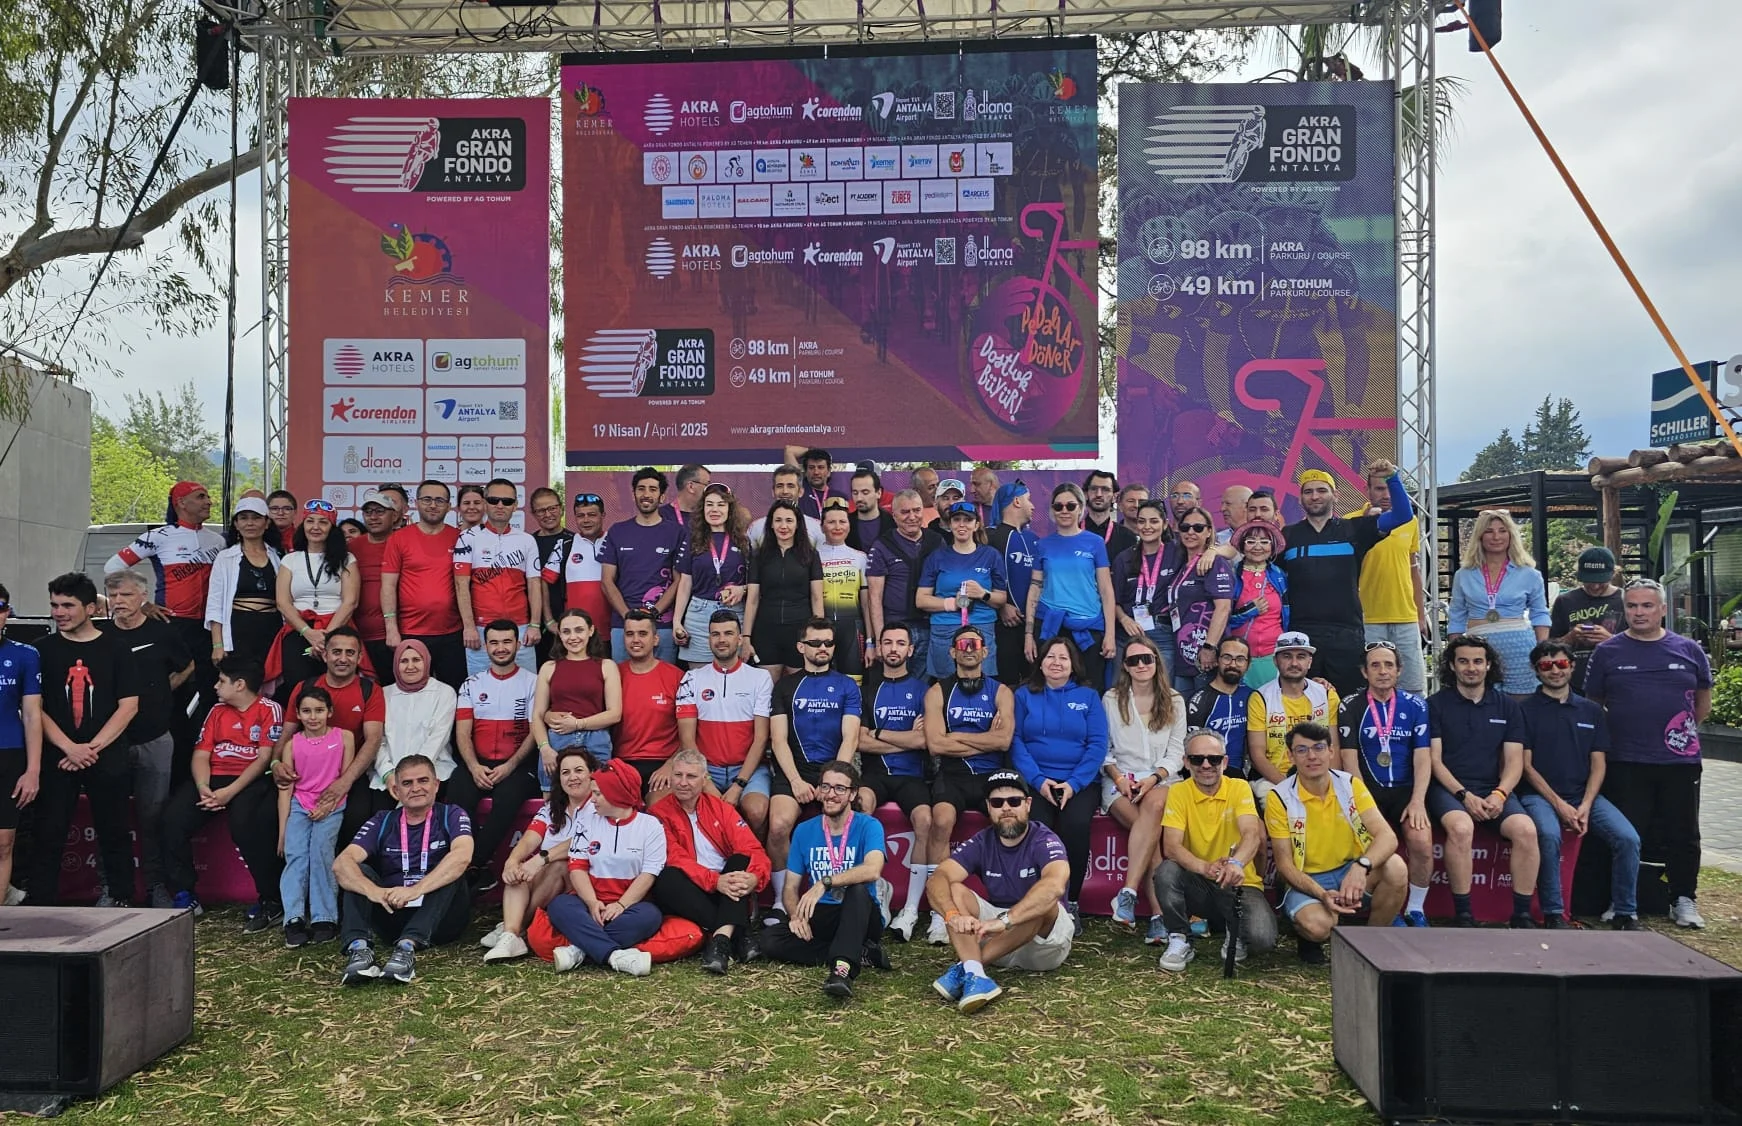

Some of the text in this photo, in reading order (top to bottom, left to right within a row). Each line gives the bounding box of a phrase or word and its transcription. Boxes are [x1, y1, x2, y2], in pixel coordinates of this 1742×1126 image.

[680, 100, 719, 113] AKRA
[896, 104, 933, 112] ANTALYA
[978, 90, 1012, 114] diana
[747, 104, 792, 119] agtohum
[817, 104, 862, 117] corendon
[1049, 105, 1088, 114] KEMER
[576, 120, 613, 128] KEMER
[680, 117, 720, 127] HOTELS
[896, 114, 917, 122] Airport
[1298, 116, 1341, 126] AKRA
[471, 129, 512, 139] AKRA
[1282, 129, 1342, 145] GRAN
[456, 140, 512, 156] GRAN
[1269, 147, 1342, 163] FONDO
[444, 158, 512, 174] FONDO
[682, 245, 721, 258] AKRA
[897, 249, 934, 258] ANTALYA
[979, 236, 1013, 259] diana
[1180, 240, 1252, 259] 98 km
[1270, 242, 1304, 252] AKRA
[749, 249, 794, 263] agtohum
[818, 249, 863, 262] corendon
[1270, 252, 1311, 260] PARKURU
[1317, 252, 1351, 260] COURSE
[682, 261, 721, 270] HOTELS
[897, 259, 918, 267] Airport
[1180, 276, 1255, 295] 49 km
[1270, 279, 1332, 288] AG TOHUM
[385, 289, 469, 303] KEMER
[1270, 289, 1311, 297] PARKURU
[1317, 289, 1351, 297] COURSE
[677, 339, 705, 348] AKRA
[748, 340, 789, 355] 98 km
[798, 341, 818, 349] AKRA
[372, 352, 414, 362] AKRA
[455, 354, 519, 369] agtohum
[667, 350, 705, 364] GRAN
[372, 364, 415, 373] HOTELS
[660, 366, 705, 379] FONDO
[799, 370, 834, 378] AG TOHUM
[749, 368, 790, 383] 49 km
[352, 406, 417, 420] corendon
[458, 408, 496, 416] ANTALYA
[592, 424, 606, 437] 19
[609, 424, 641, 437] Nisan
[652, 423, 678, 439] April
[681, 423, 708, 436] 2025
[730, 425, 846, 435] www.akragranfondoantalya.org
[1651, 415, 1708, 438] SCHILLER
[360, 447, 402, 468] diana
[1569, 604, 1608, 622] ENJOY!
[962, 710, 993, 718] ANTALYA
[84, 827, 95, 841] 9
[1095, 836, 1128, 871] dia
[1472, 848, 1488, 859] m
[814, 861, 854, 870] COMTE
[1472, 873, 1486, 884] m
